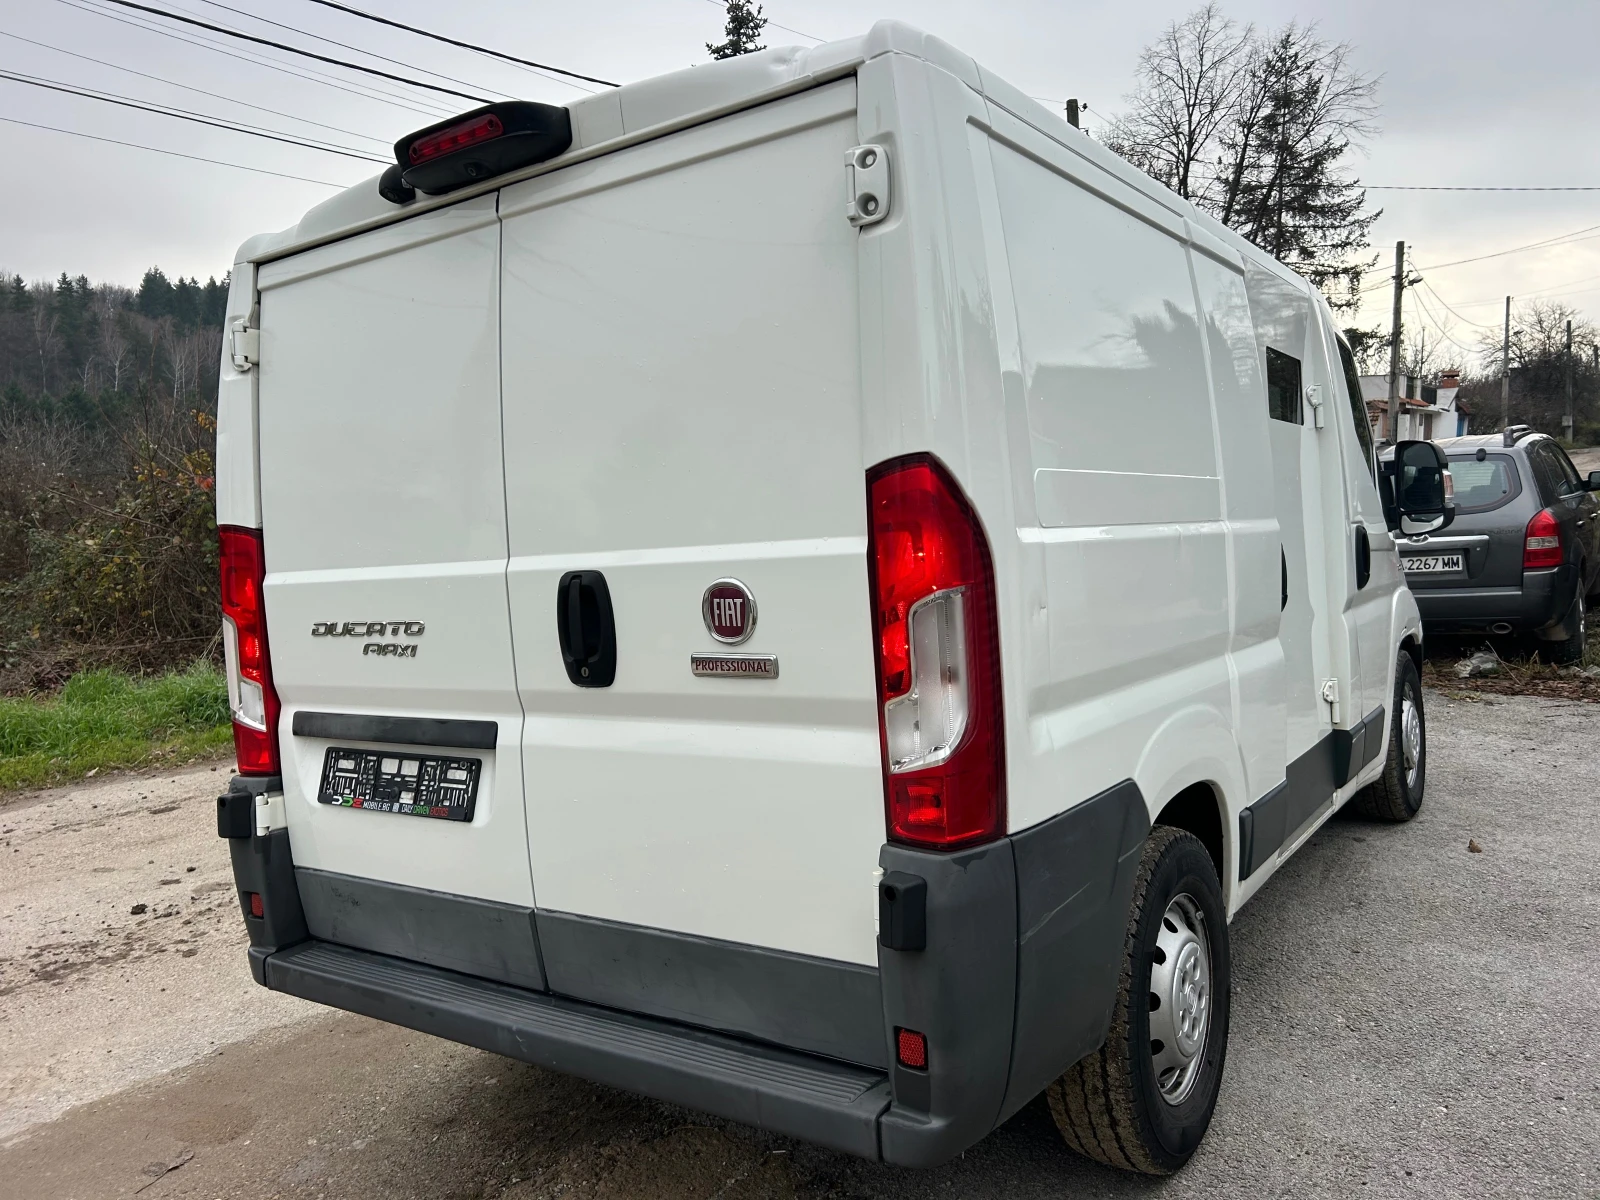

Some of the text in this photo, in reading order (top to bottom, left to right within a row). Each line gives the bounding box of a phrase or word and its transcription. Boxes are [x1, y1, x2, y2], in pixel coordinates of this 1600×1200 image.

[1442, 556, 1460, 569] MM
[713, 598, 743, 627] FIAT
[311, 620, 425, 637] DUCATO
[362, 642, 418, 658] MAXI
[695, 660, 770, 673] PROFESSIONAL
[402, 804, 413, 813] DAILY
[413, 805, 430, 814] DRIVEN
